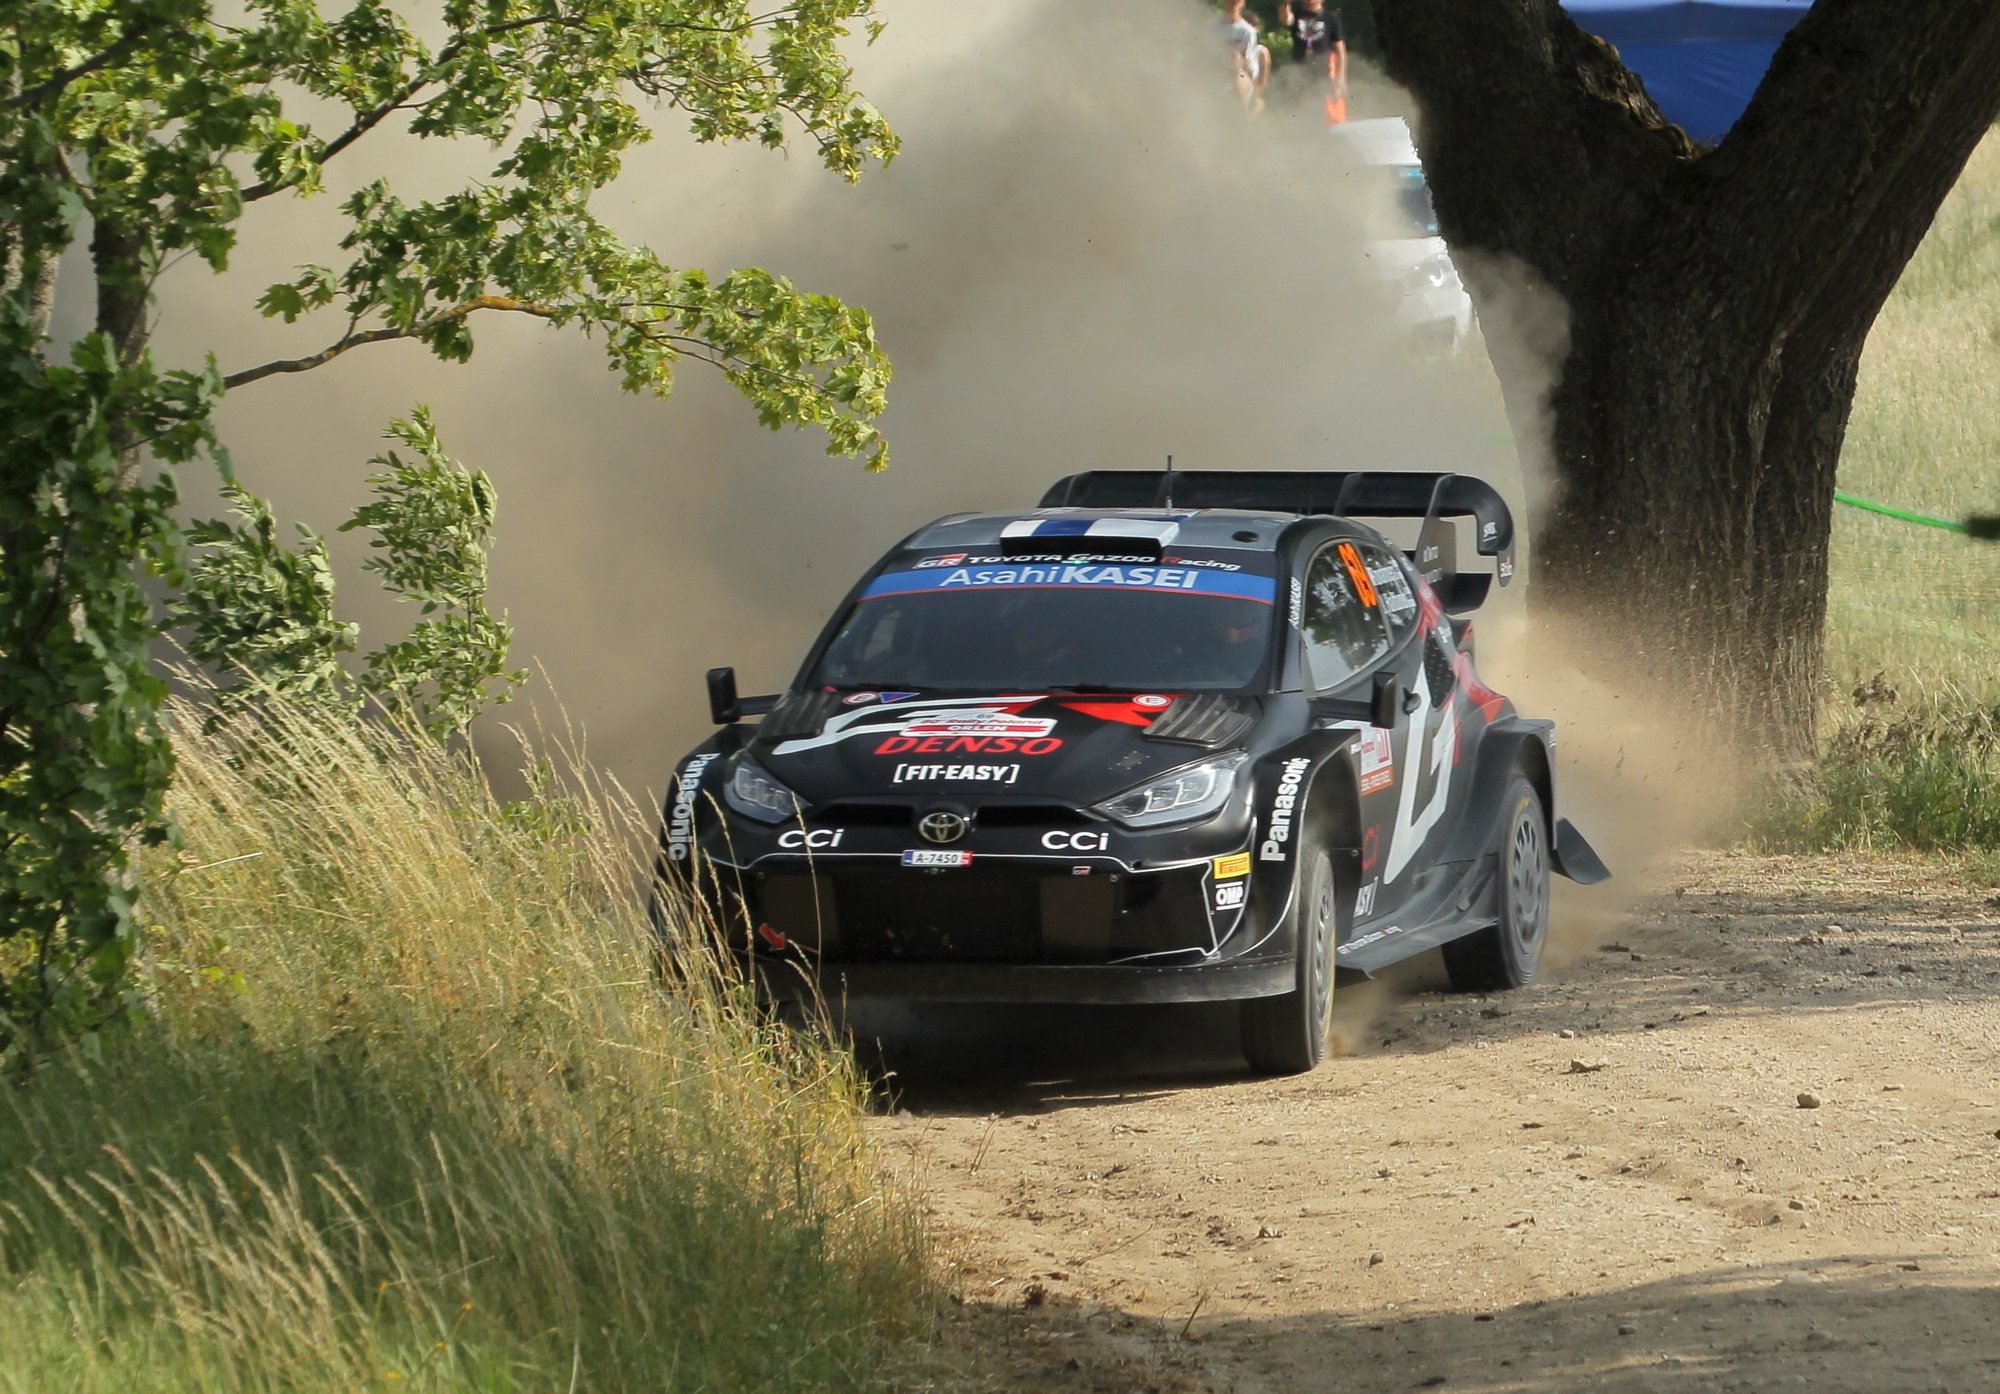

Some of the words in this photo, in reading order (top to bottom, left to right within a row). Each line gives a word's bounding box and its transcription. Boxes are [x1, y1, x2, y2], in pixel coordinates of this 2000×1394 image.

[968, 553, 1062, 565] TOYOTA
[1068, 553, 1156, 564] GAZOO
[1161, 555, 1242, 572] Racing
[939, 566, 1199, 588] AsahiKASEI
[873, 736, 1063, 755] DENSO
[668, 752, 721, 861] Panasonic
[1259, 757, 1312, 862] Panasonic
[777, 828, 845, 848] CCi
[1041, 830, 1110, 851] CCi
[915, 853, 958, 864] A-7450
[1216, 885, 1244, 905] OMP
